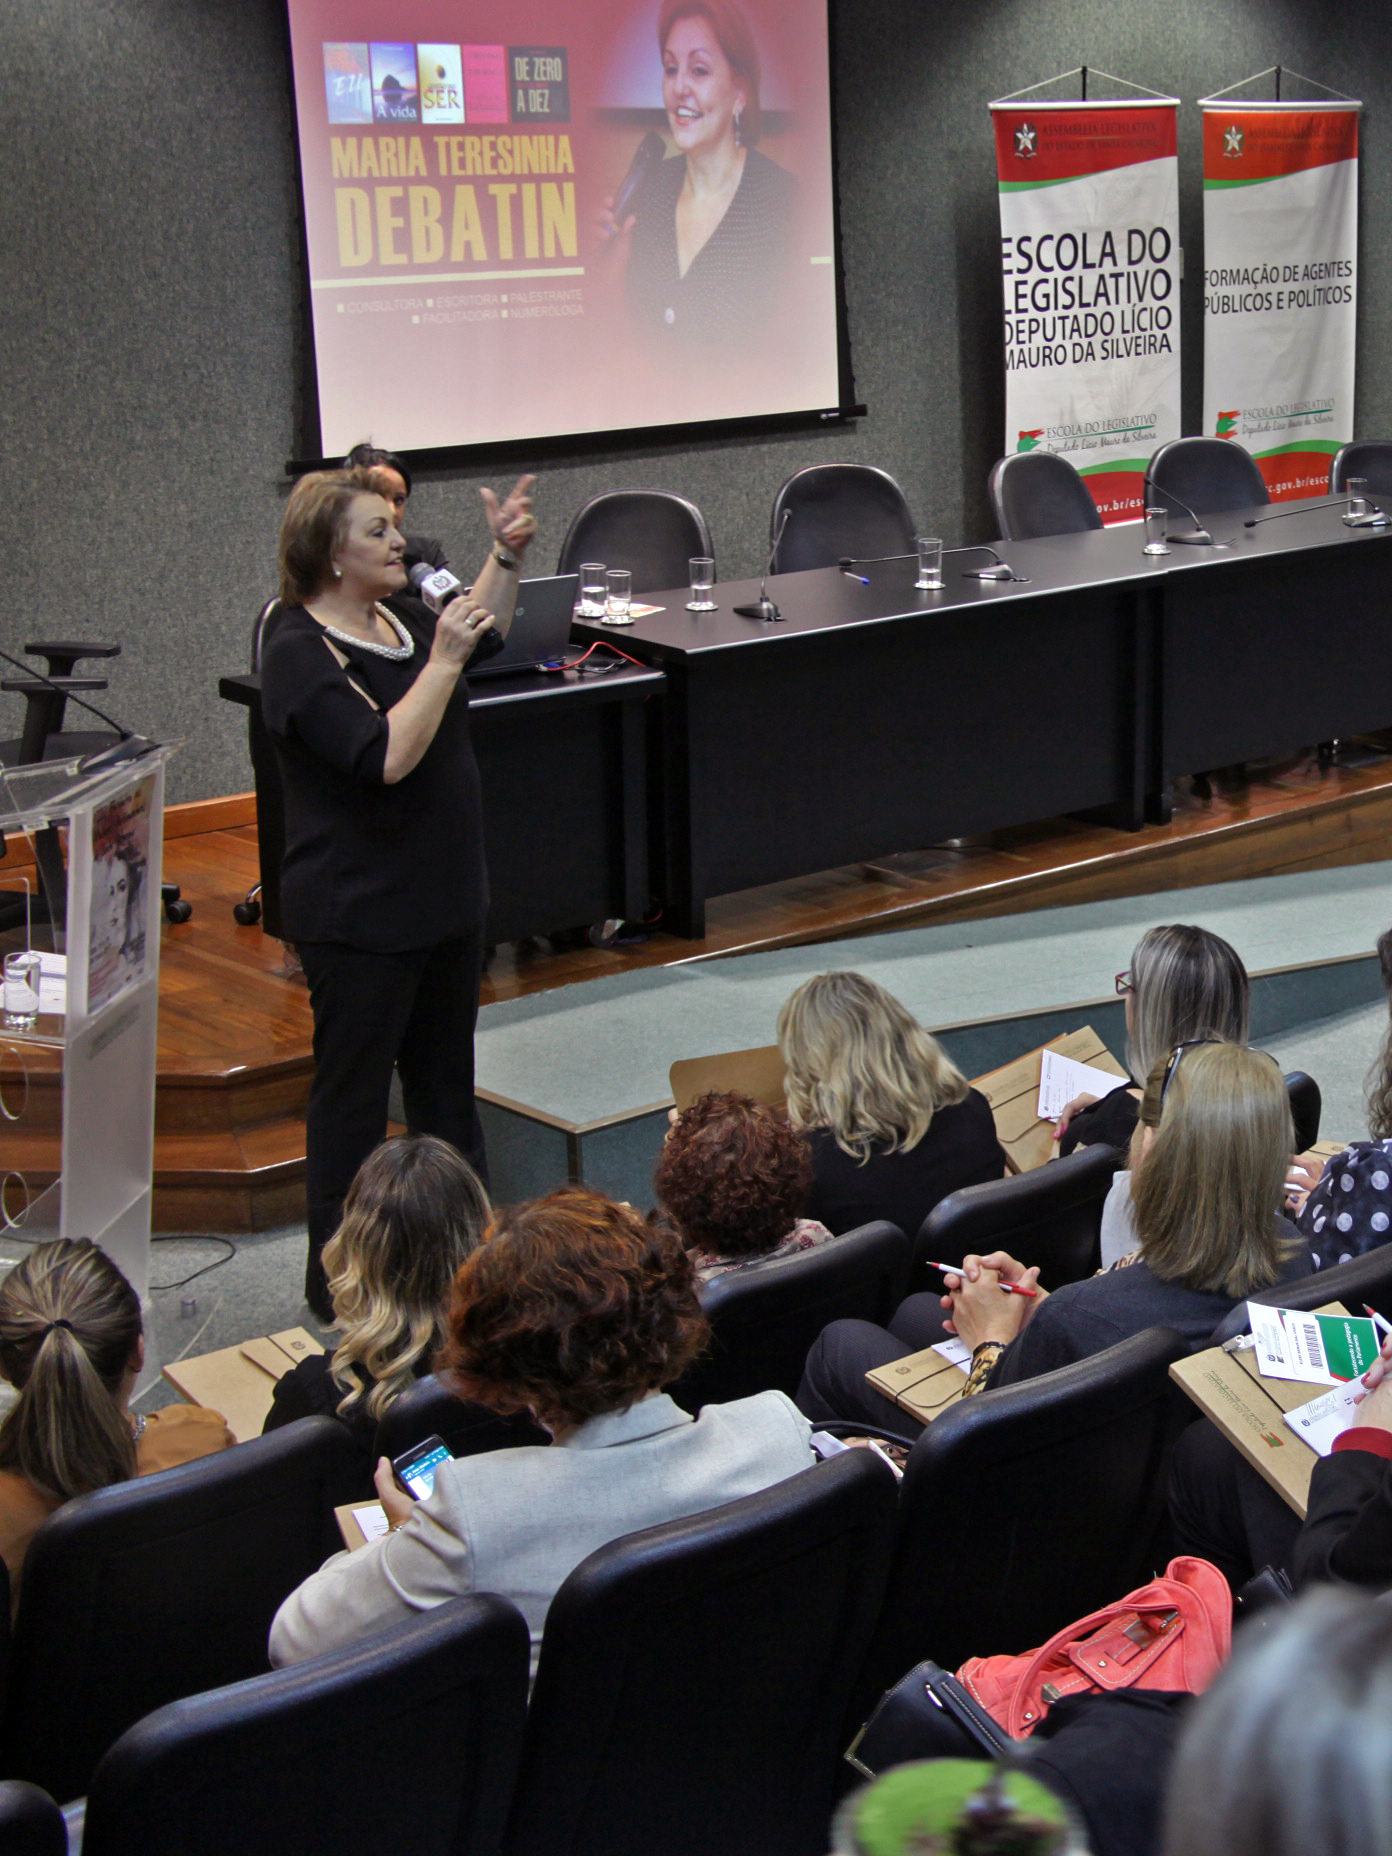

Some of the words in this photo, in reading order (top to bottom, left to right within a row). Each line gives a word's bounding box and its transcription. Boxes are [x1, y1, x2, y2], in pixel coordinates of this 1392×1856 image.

[514, 56, 530, 81] DE
[533, 56, 563, 82] ZERO
[376, 105, 388, 119] A
[389, 104, 417, 119] vida
[423, 89, 462, 110] SER
[516, 89, 526, 113] A
[528, 89, 550, 113] DEZ
[330, 136, 428, 178] MARIA
[433, 135, 576, 177] TERESINHA
[334, 182, 579, 267] DEBATIN
[1001, 230, 1118, 275] ESCOLA
[1127, 226, 1171, 267] DO
[1204, 263, 1280, 290] FORMAÇÃO
[1283, 265, 1299, 283] DE
[1302, 260, 1353, 281] AGENTES
[437, 293, 499, 309] ESCRITORA
[509, 288, 583, 304] PALESTRANTE
[1204, 292, 1272, 315] PÚBLICOS
[1276, 291, 1284, 310] E
[1288, 285, 1353, 309] POLÍTICOS
[1004, 311, 1115, 347] DEPUTADO
[1121, 303, 1172, 335] LÍCIO
[1072, 341, 1096, 364] DA
[1100, 333, 1172, 361] SILVEIRA
[1242, 408, 1273, 420] ESCOLA
[1276, 405, 1289, 416] DO
[1290, 398, 1335, 414] LEGISLATIVO
[1047, 424, 1081, 439] ESCOLA
[1085, 421, 1099, 433] DO
[1102, 413, 1157, 431] LEGISLATIVO
[1122, 431, 1130, 443] da
[1132, 429, 1157, 443] Silveira
[1242, 422, 1270, 439] Deputado
[1343, 1322, 1354, 1344] pedagogia
